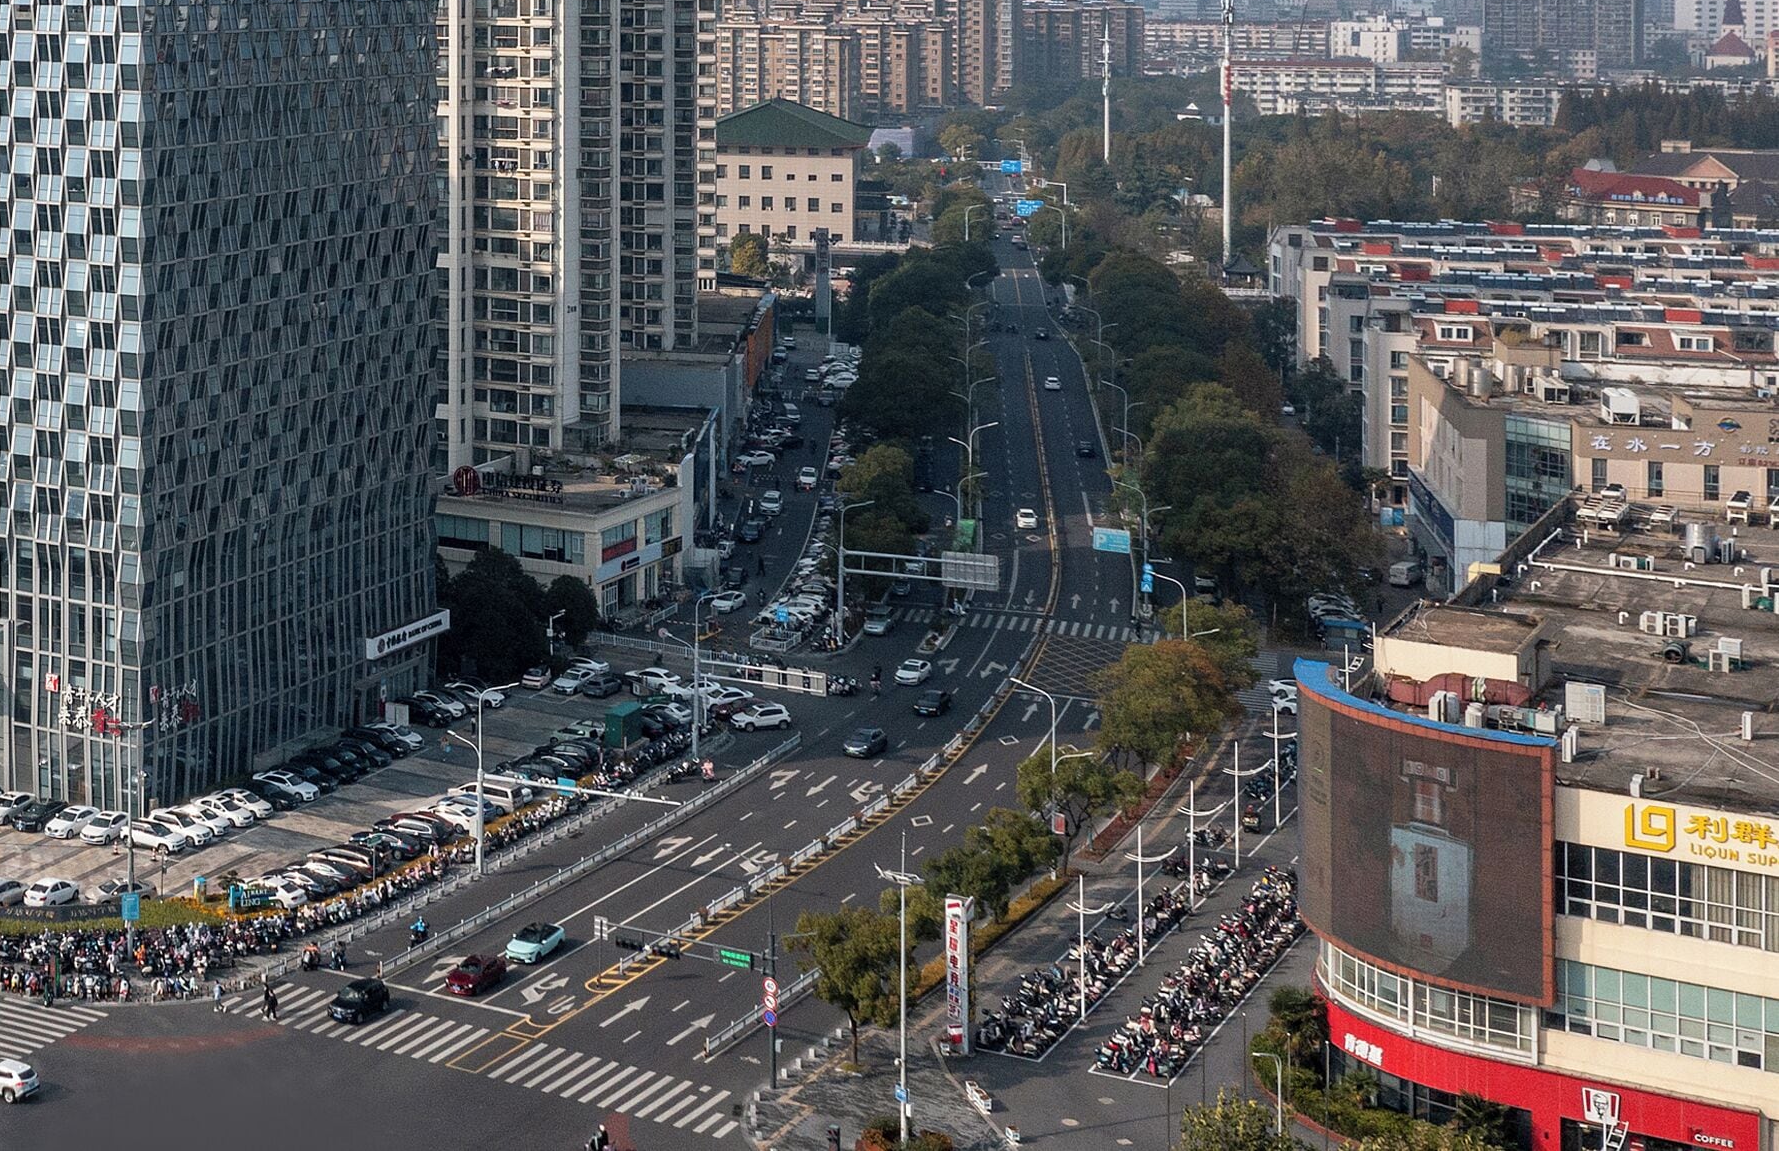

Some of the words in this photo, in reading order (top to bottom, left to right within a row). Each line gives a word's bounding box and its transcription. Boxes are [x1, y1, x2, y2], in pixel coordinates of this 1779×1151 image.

[1591, 434, 1716, 457] 在水一方
[510, 491, 563, 504] SECURITIES
[1683, 815, 1779, 850] 利群
[1690, 843, 1740, 862] LIQUN
[1747, 853, 1779, 867] SUP
[1694, 1133, 1735, 1148] COFFEE
